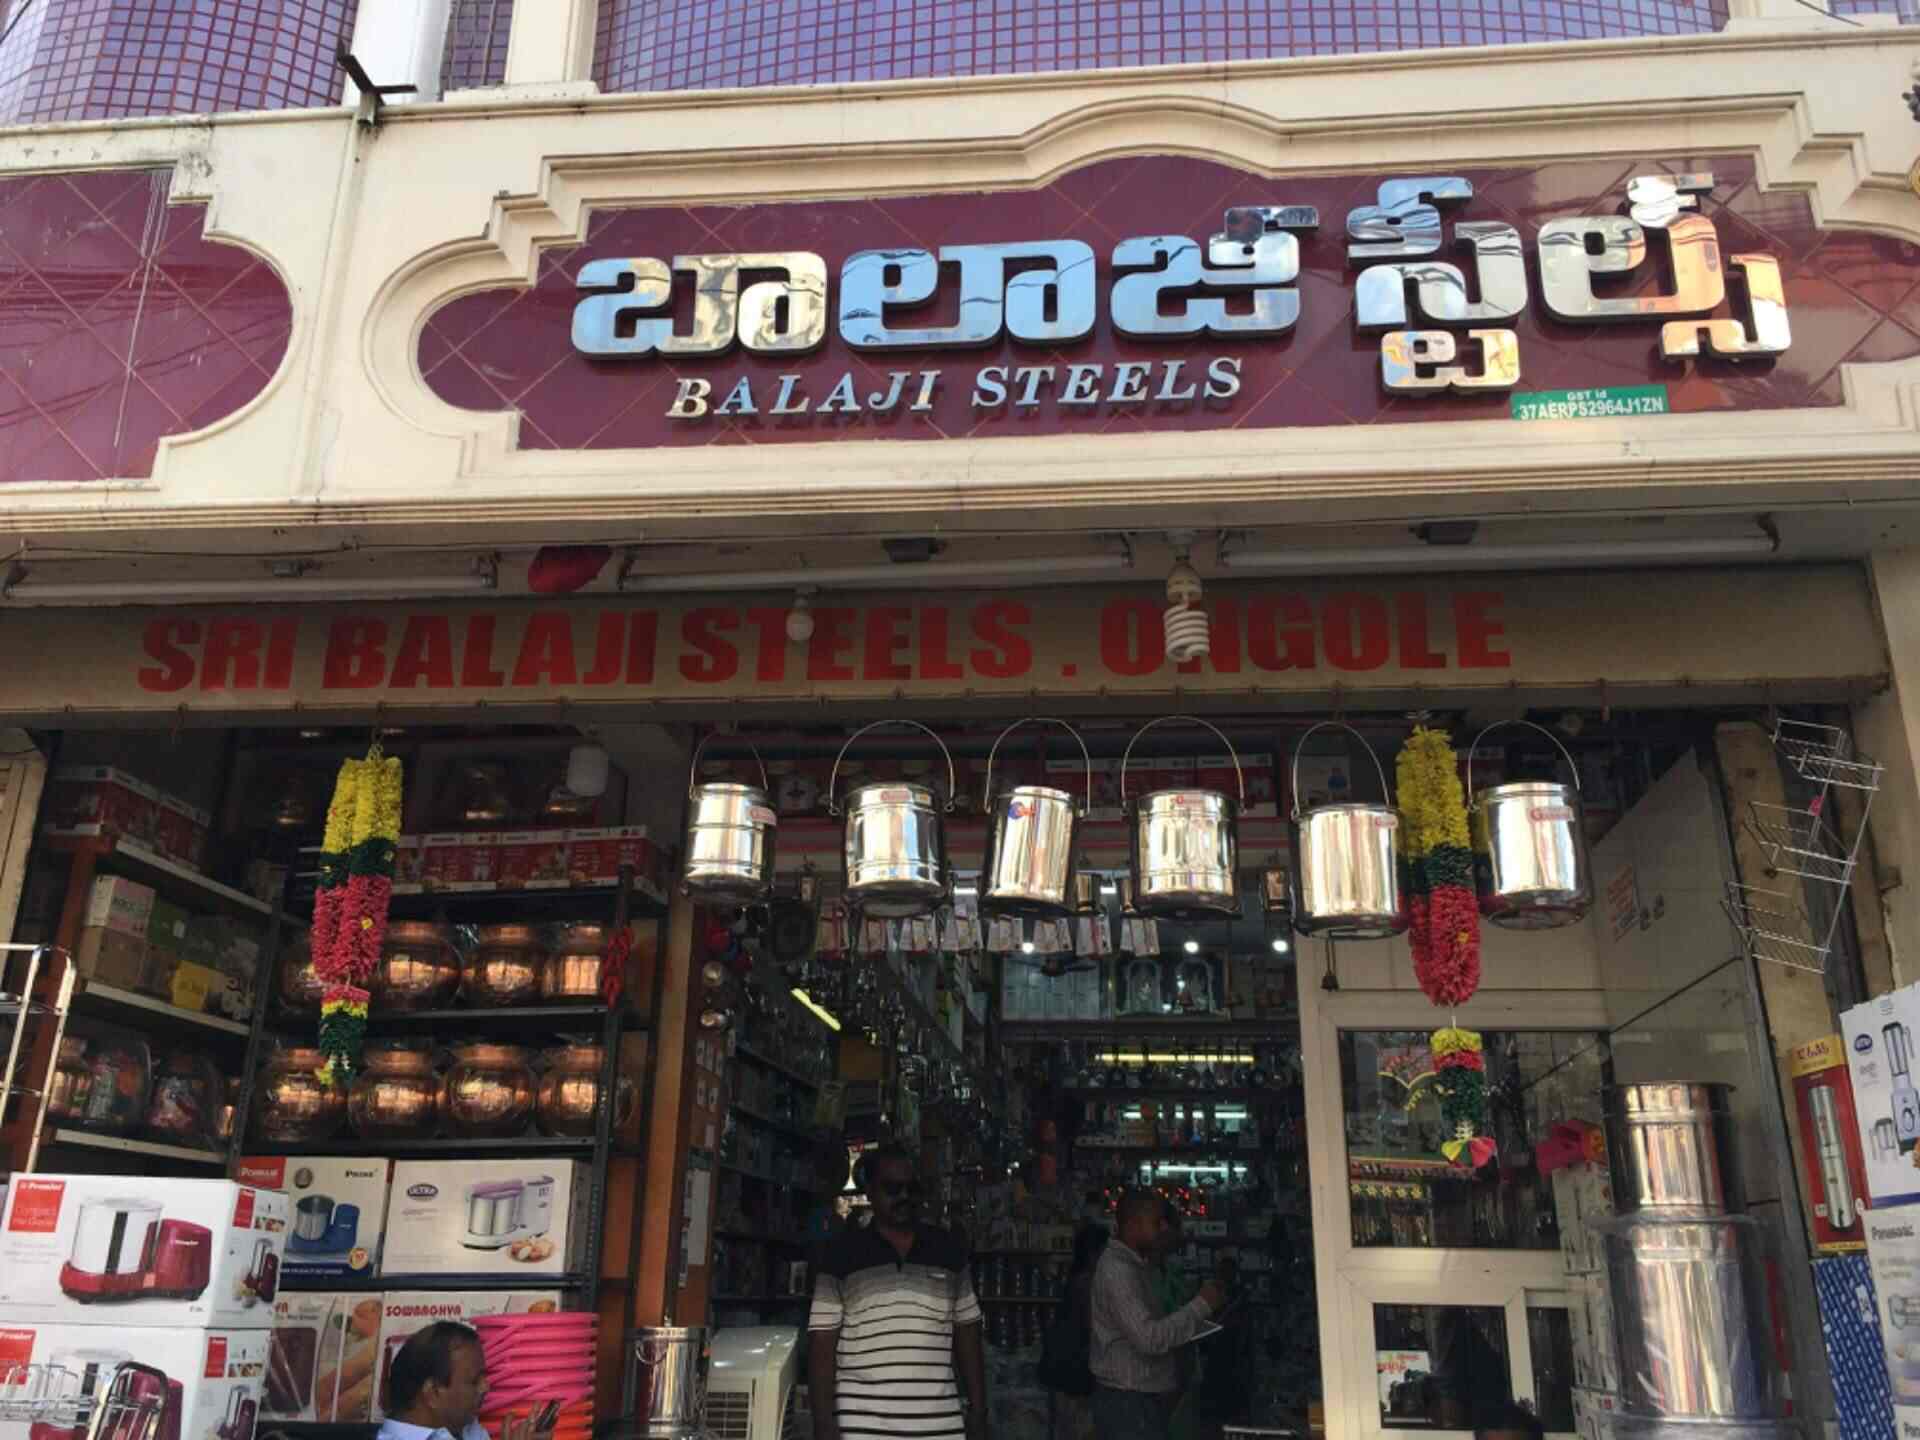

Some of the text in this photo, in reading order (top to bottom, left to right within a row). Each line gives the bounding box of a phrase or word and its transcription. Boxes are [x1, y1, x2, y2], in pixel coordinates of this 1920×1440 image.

[665, 357, 1243, 417] BALAJI STEELS
[1567, 390, 1590, 401] GST
[137, 615, 300, 693] SRI
[322, 609, 658, 689] BALAJI
[678, 600, 1032, 683] STEELS
